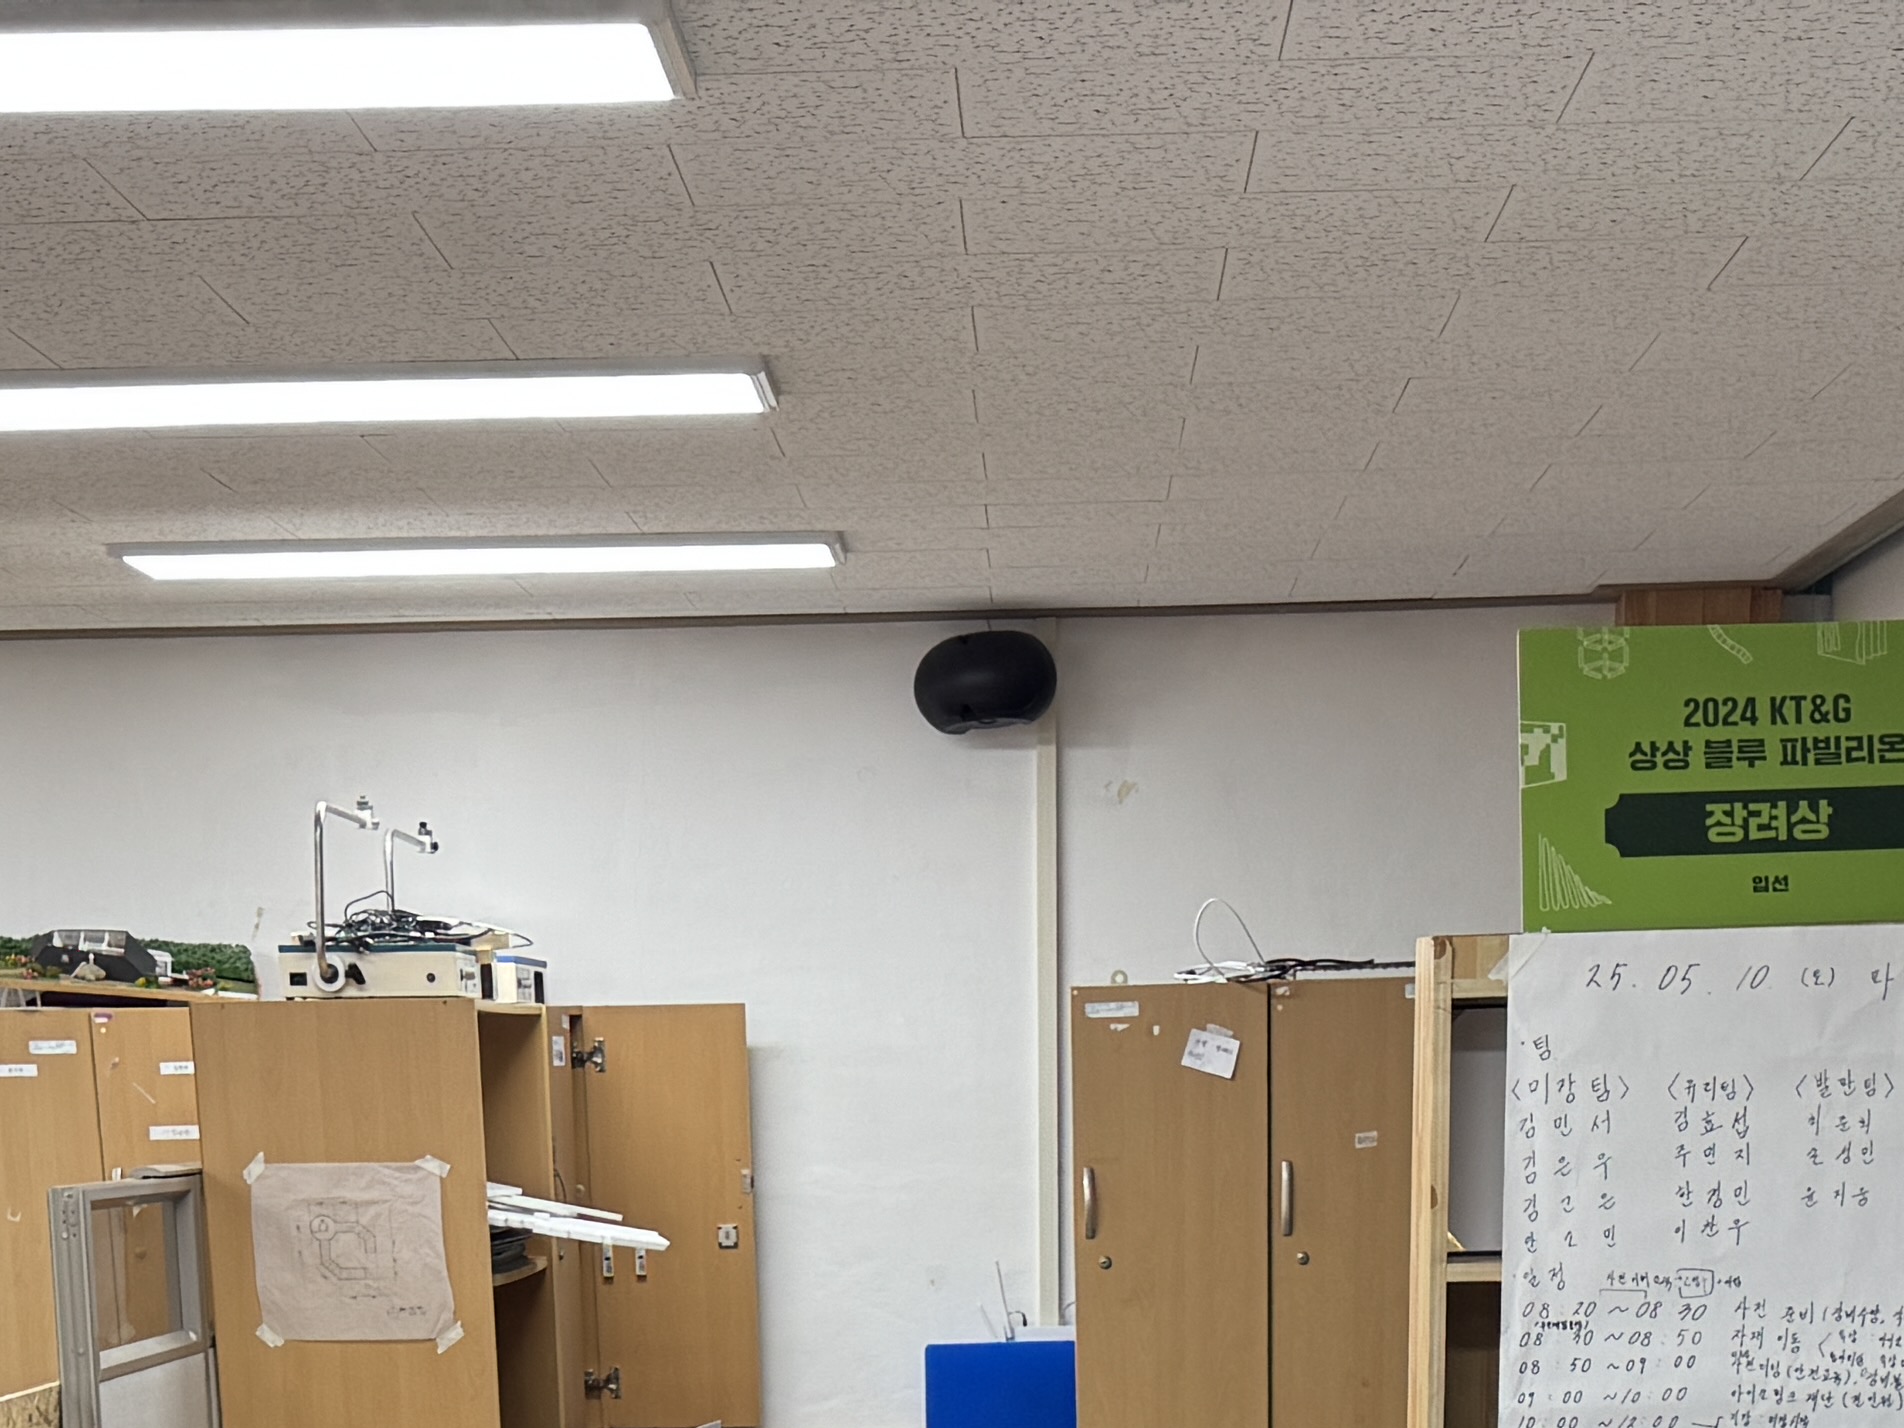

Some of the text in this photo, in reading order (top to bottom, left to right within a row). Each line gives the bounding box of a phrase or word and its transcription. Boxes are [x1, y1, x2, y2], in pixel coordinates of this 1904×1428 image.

[1684, 694, 1852, 728] 2024 KT&G
[1628, 740, 1693, 771] 상상
[1703, 738, 1768, 768] 블루
[1705, 800, 1833, 844] 장려상
[1751, 874, 1789, 893] 입선
